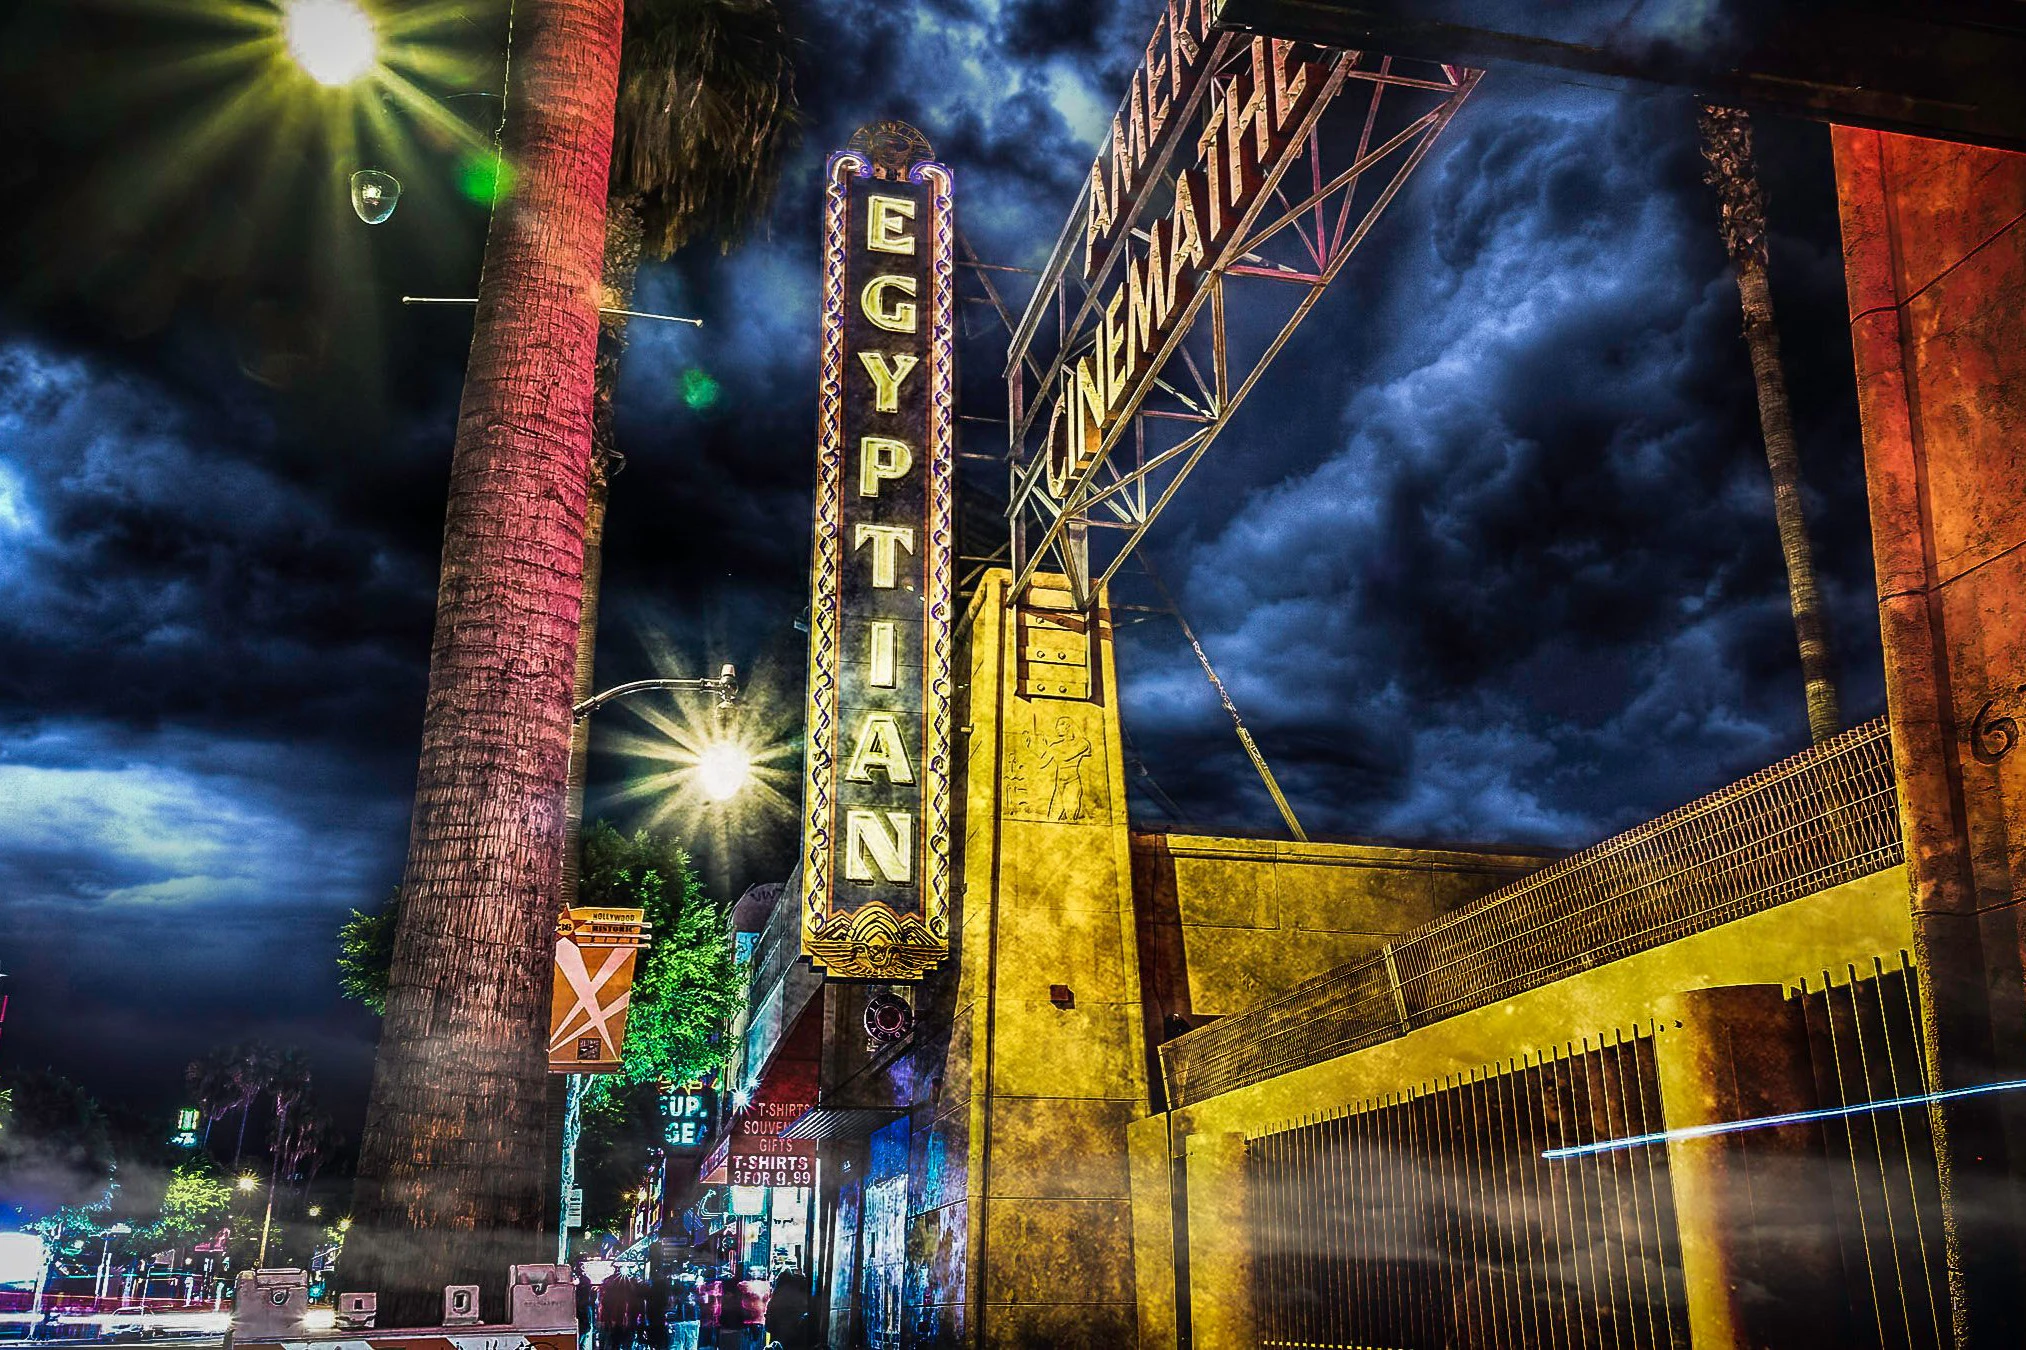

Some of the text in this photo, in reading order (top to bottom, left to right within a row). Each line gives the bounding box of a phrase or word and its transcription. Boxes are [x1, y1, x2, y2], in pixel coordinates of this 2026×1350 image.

[844, 194, 919, 885] EGYPTIAN
[592, 912, 635, 922] HOLLYWOOD
[759, 1138, 793, 1153] GIFTS
[732, 1155, 809, 1171] T-SHIRTS
[776, 1170, 811, 1187] 9.99
